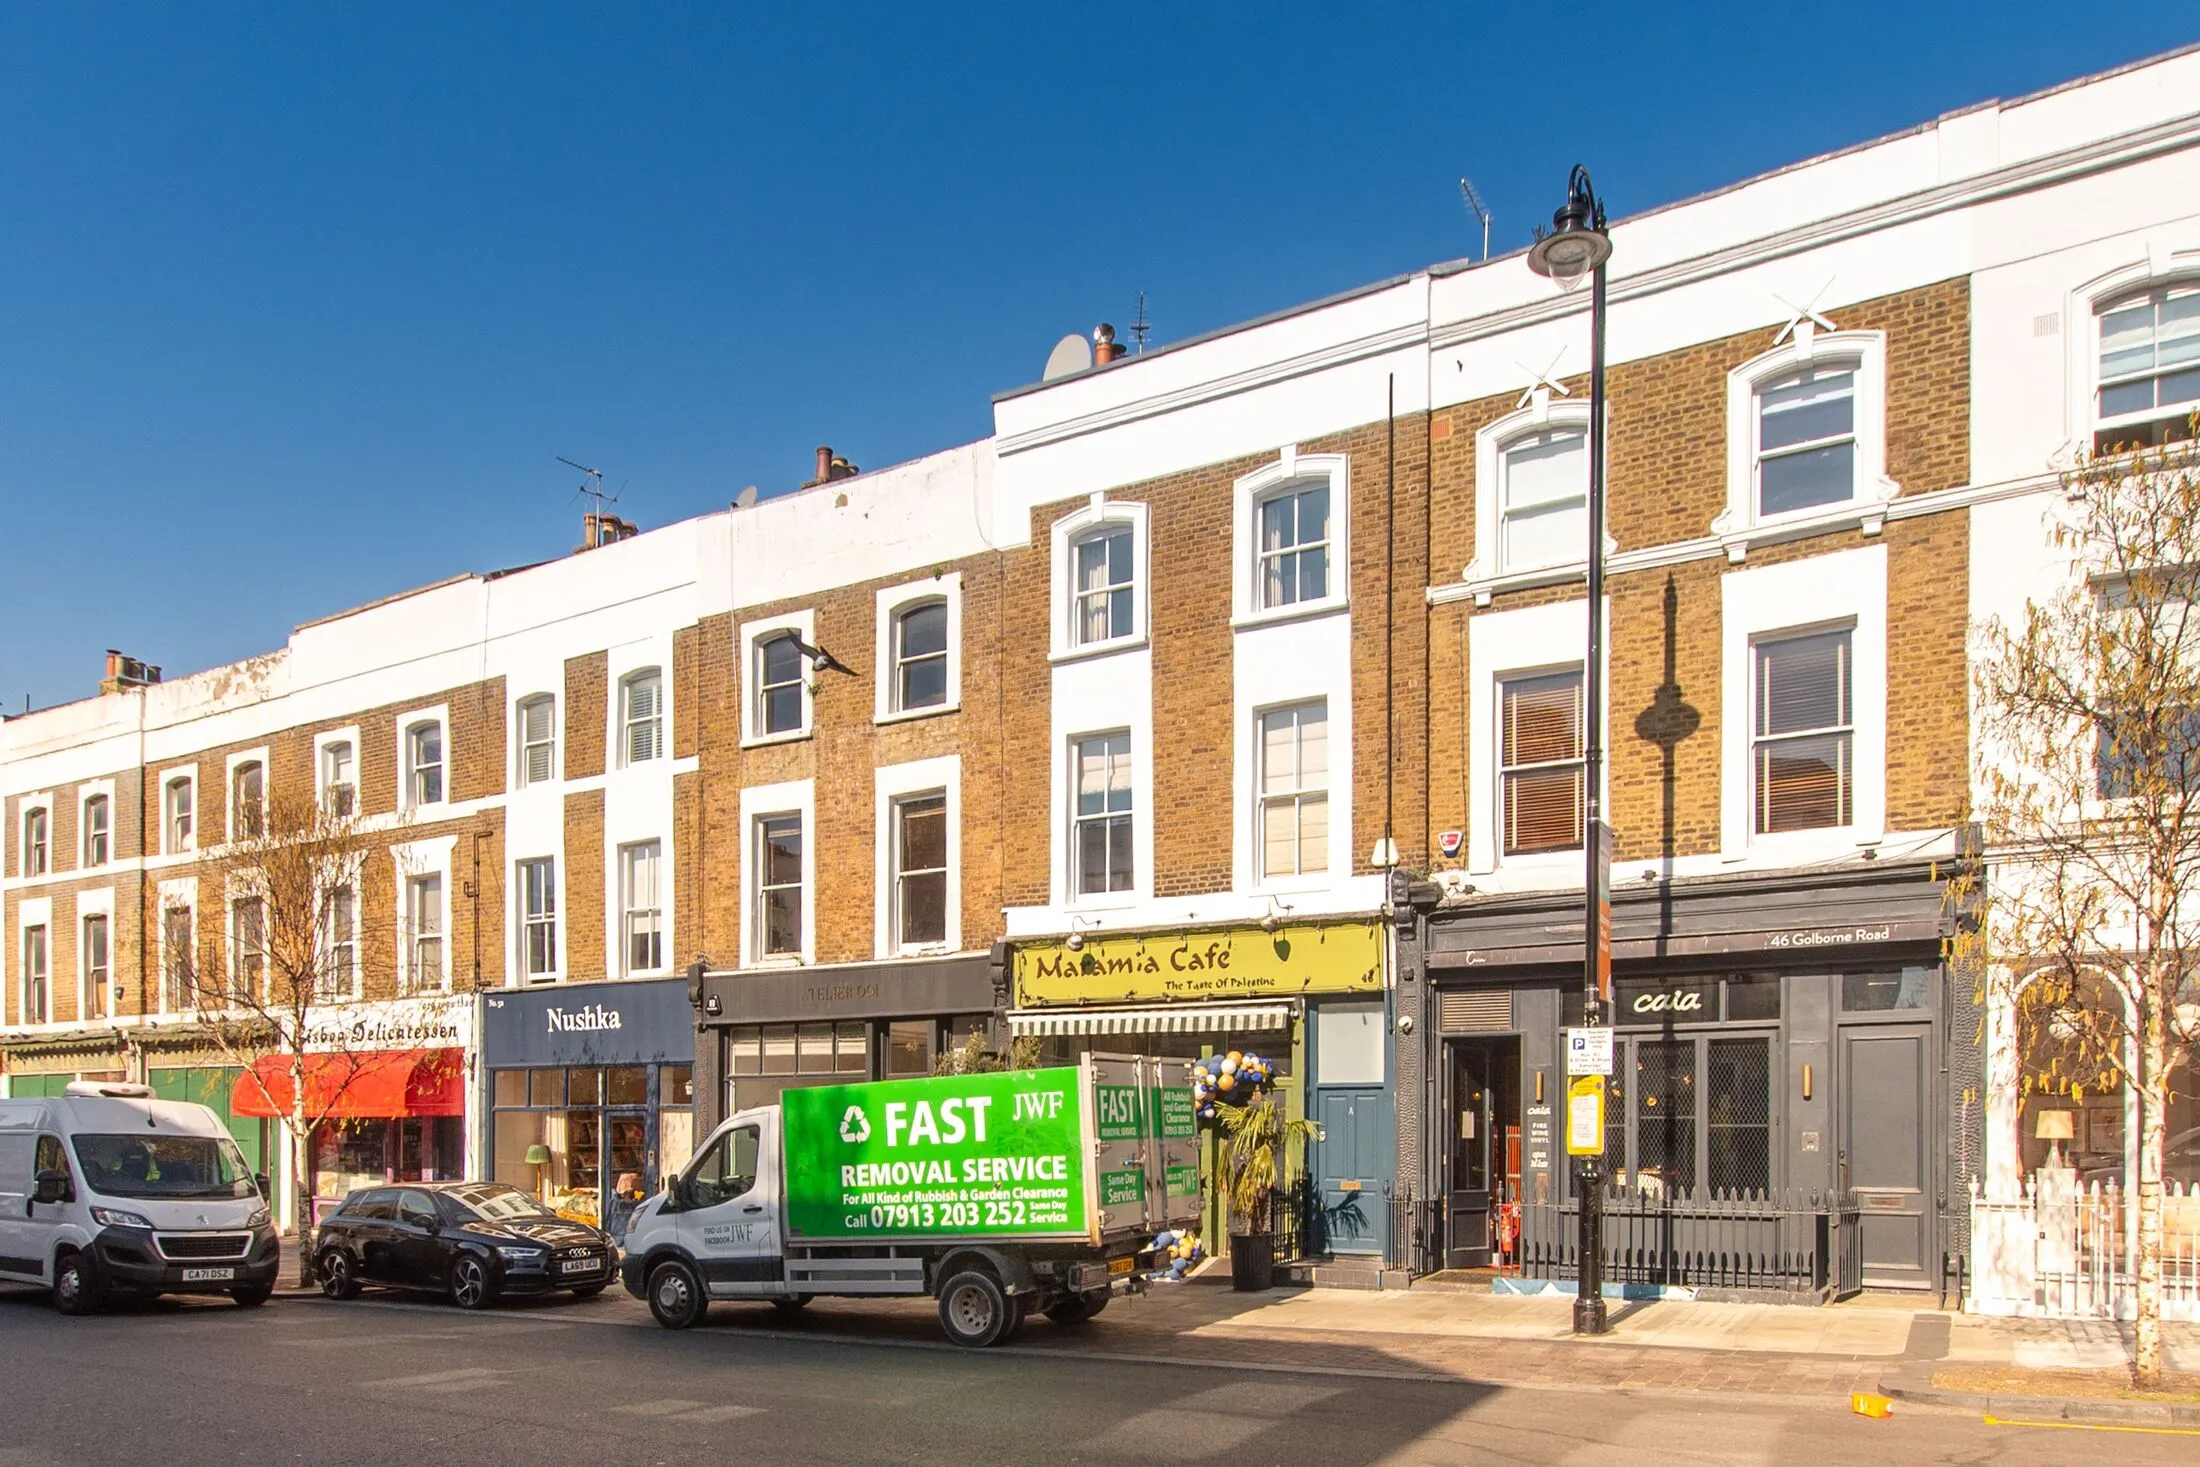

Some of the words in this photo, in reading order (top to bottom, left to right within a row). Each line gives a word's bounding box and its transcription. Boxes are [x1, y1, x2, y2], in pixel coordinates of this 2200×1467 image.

[1770, 934, 1789, 946] 46
[1792, 932, 1852, 946] Golborne
[1856, 927, 1890, 941] Road
[1170, 942, 1230, 972] Cafe
[1165, 981, 1184, 990] The
[1186, 980, 1212, 990] Taste
[1216, 978, 1228, 988] Of
[1231, 977, 1275, 987] Palestine
[1633, 990, 1702, 1013] caia
[547, 1004, 622, 1032] Nushka
[351, 1019, 458, 1043] Delicatessen
[1013, 1091, 1064, 1121] JWF
[1099, 1089, 1135, 1123] FAST
[1348, 1106, 1354, 1115] A
[885, 1096, 992, 1147] FAST
[841, 1160, 958, 1187] REMOVAL
[962, 1155, 1067, 1183] SERVICE
[1108, 1174, 1125, 1186] Same
[1125, 1173, 1136, 1186] Day
[843, 1194, 860, 1205] For
[861, 1192, 875, 1204] All
[876, 1190, 899, 1204] Kind
[901, 1190, 913, 1203] of
[915, 1189, 957, 1203] Rubbish
[959, 1189, 968, 1201] &
[970, 1188, 1011, 1201] Garden
[1013, 1187, 1067, 1199] Clearance
[1107, 1187, 1137, 1203] Service
[845, 1215, 867, 1228] Call
[871, 1203, 935, 1228] 07913
[940, 1202, 980, 1227] 203
[985, 1201, 1026, 1226] 252
[1029, 1201, 1051, 1210] Same
[1052, 1201, 1067, 1211] Day
[1029, 1211, 1067, 1224] Service
[731, 1223, 753, 1243] JWF
